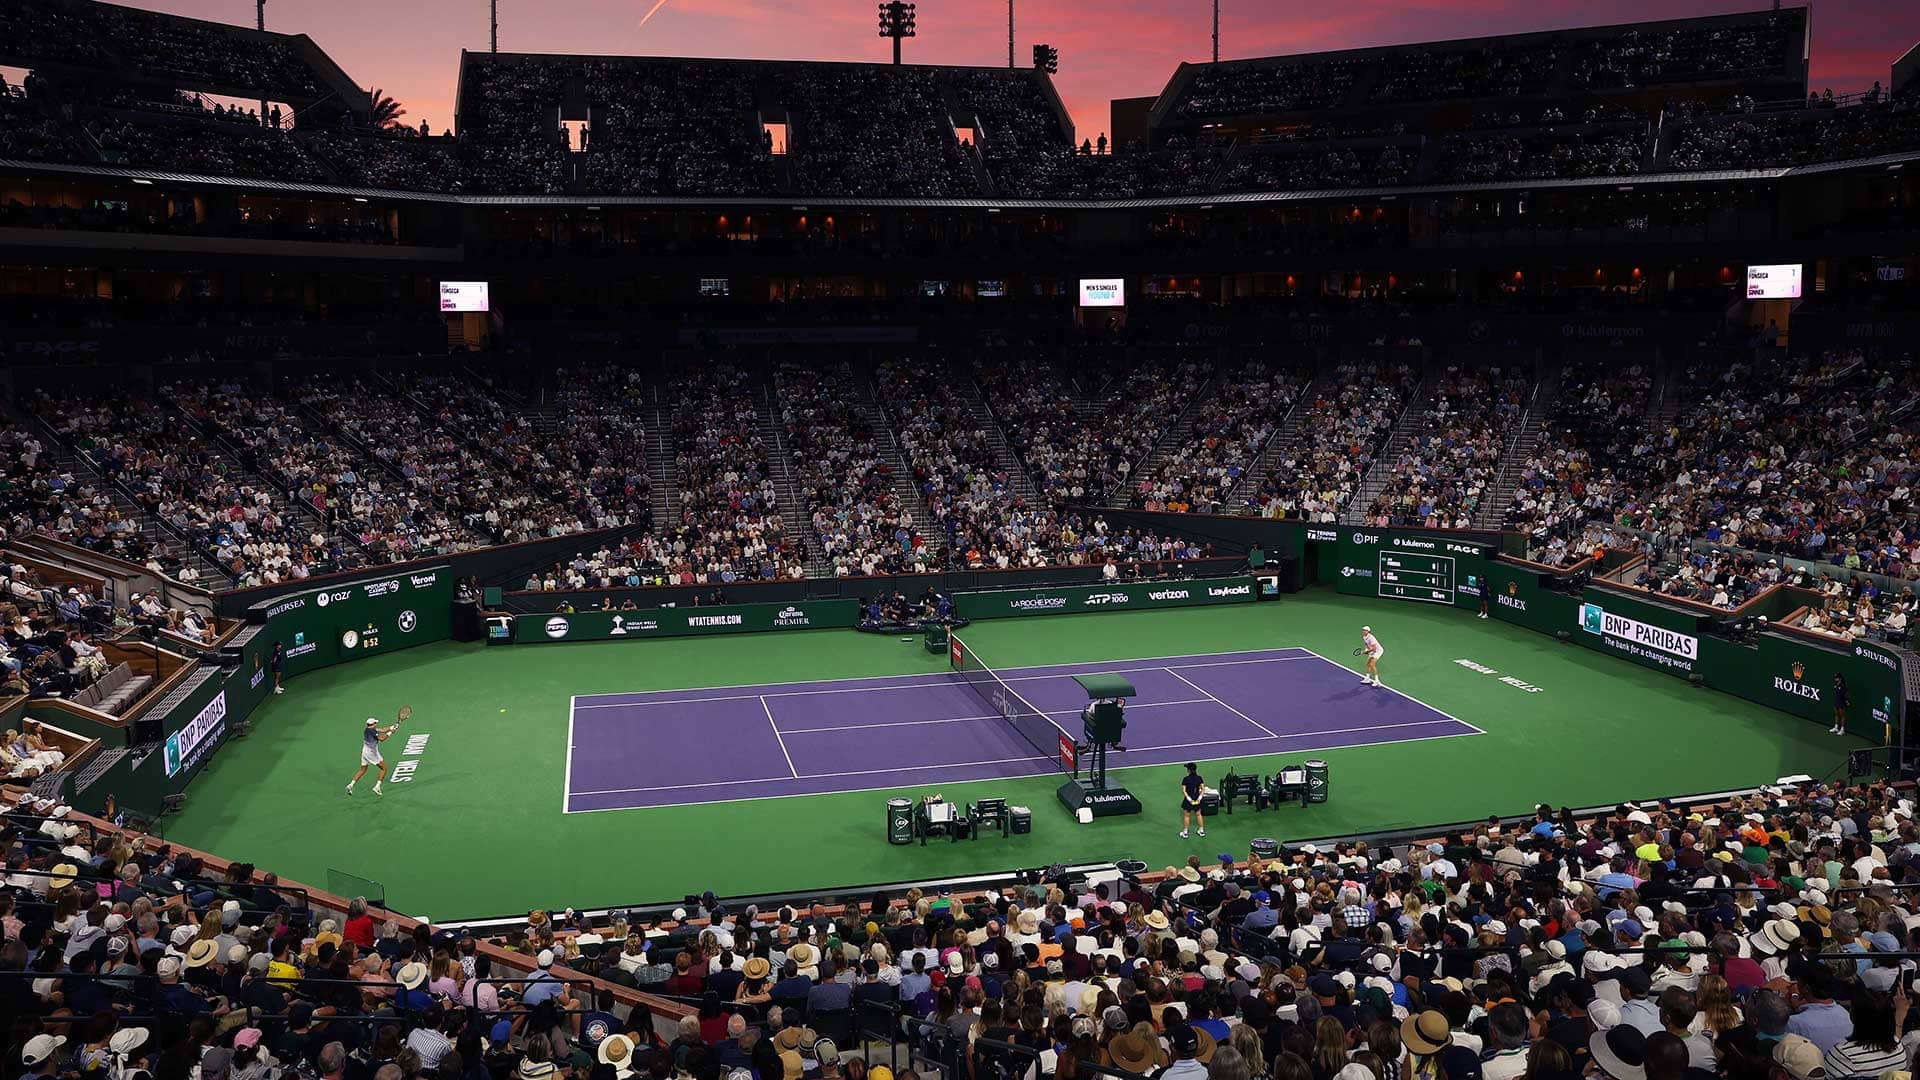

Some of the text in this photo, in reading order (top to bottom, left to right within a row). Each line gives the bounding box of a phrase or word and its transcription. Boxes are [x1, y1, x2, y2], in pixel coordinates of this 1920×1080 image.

[1364, 535, 1379, 544] PIF
[1401, 538, 1435, 549] lululemon
[410, 573, 436, 586] Veroni
[330, 590, 351, 602] razr
[1148, 589, 1189, 601] verizon
[1208, 586, 1250, 597] Laykold
[1084, 594, 1111, 605] ATP
[1111, 595, 1129, 603] 1000
[1498, 594, 1526, 611] ROLEX
[547, 623, 567, 631] PEPSI
[688, 615, 742, 627] WTATENNIS.COM
[774, 618, 810, 626] PREMIER
[1605, 615, 1692, 655] BNP PARIBAS
[1605, 637, 1615, 647] The
[1615, 640, 1630, 651] bank
[1630, 645, 1640, 654] for
[1645, 650, 1673, 667] changing
[1673, 661, 1692, 671] world
[1453, 659, 1544, 693] INDIAN WELLS
[1774, 676, 1820, 701] ROLEX
[180, 695, 224, 755] BNP PARIBAS
[390, 760, 420, 782] WELLS
[1094, 794, 1131, 803] lululemon
